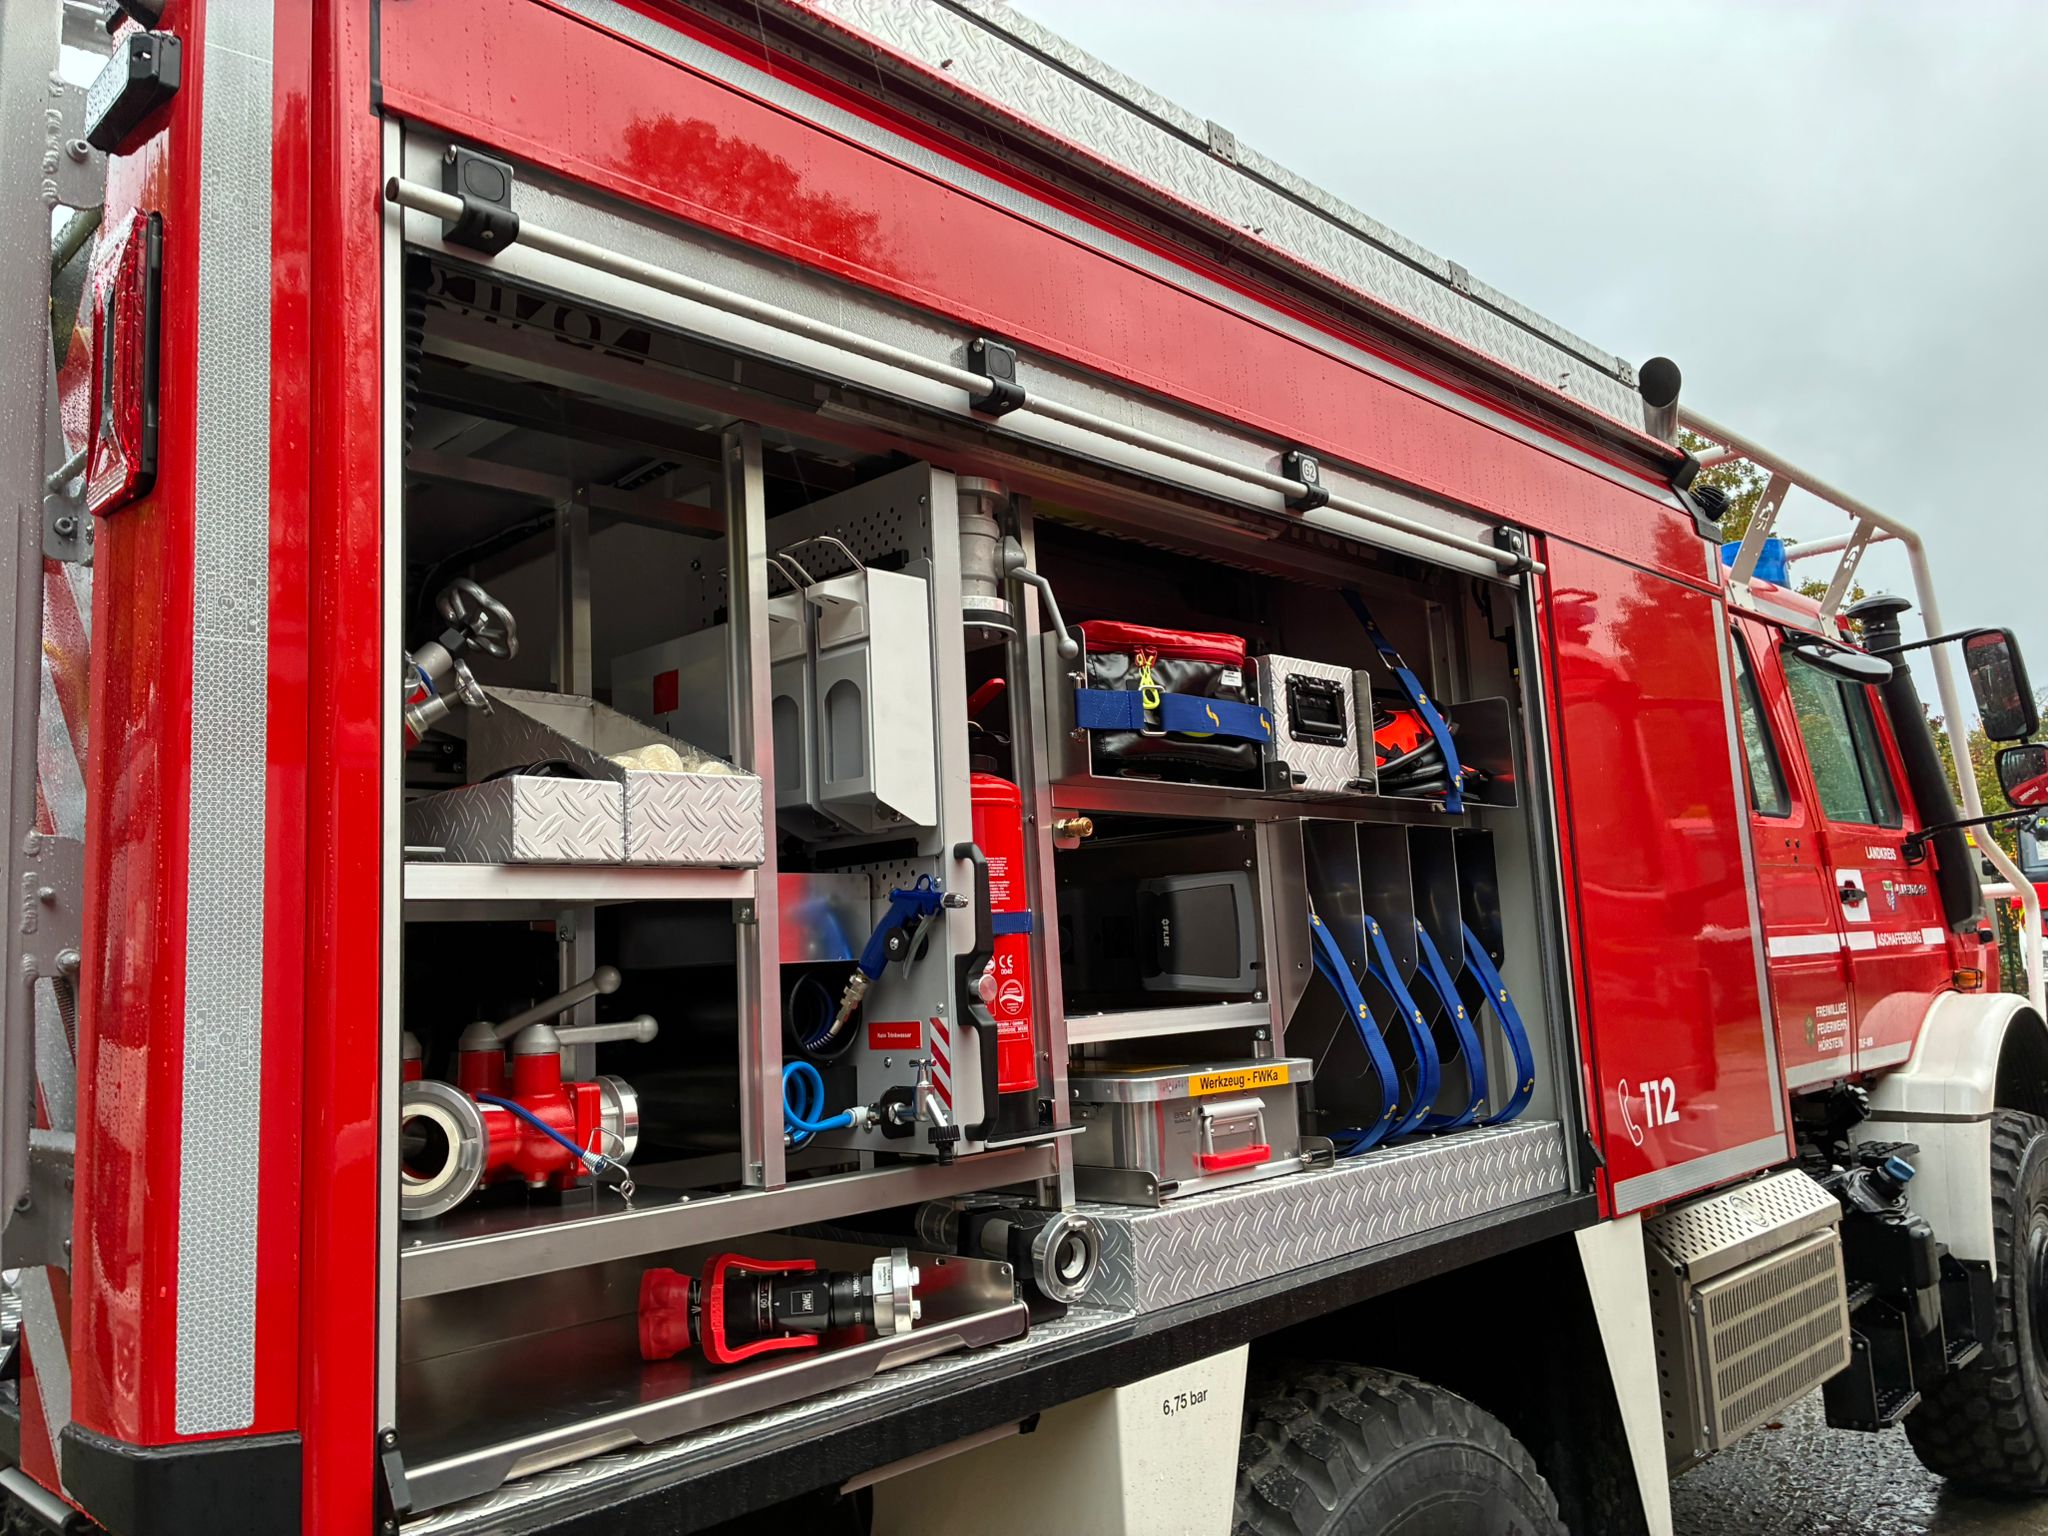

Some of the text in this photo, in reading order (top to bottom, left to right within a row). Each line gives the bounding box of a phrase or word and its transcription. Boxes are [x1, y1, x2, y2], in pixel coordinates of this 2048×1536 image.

[1303, 463, 1315, 479] G2
[1864, 845, 1897, 861] LANDKREIS
[1877, 930, 1922, 947] ASCHAFFENBURG
[998, 954, 1014, 968] CE
[1816, 1003, 1847, 1017] FREIWILLIGE
[1816, 1018, 1848, 1036] FEUERWEHR
[1817, 1037, 1844, 1053] HÖRSTEIN
[1199, 1075, 1245, 1089] Werkzeug
[1252, 1071, 1279, 1084] FWKa
[1639, 1077, 1680, 1128] 112
[853, 1276, 861, 1298] TURBO
[801, 1293, 812, 1311] AWG
[1162, 1389, 1208, 1416] 6,75 bar
